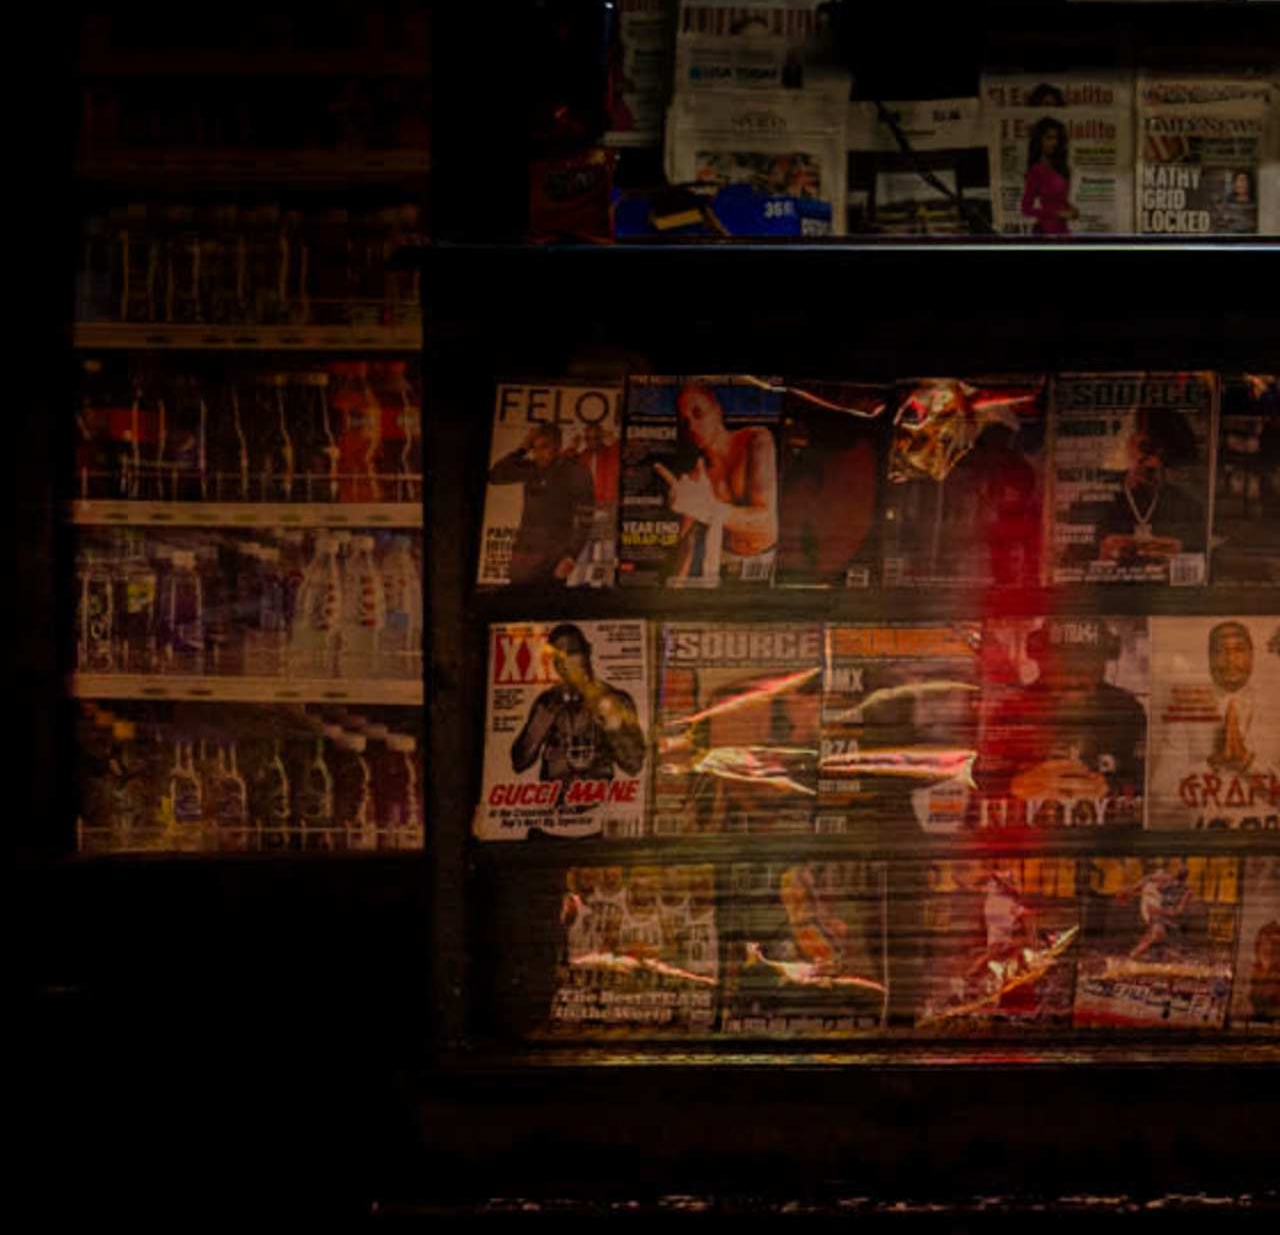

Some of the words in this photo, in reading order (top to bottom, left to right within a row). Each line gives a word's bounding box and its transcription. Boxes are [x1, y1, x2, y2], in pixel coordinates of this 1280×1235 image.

[1142, 166, 1200, 189] KATHY
[1143, 190, 1186, 209] GRID
[1142, 210, 1210, 233] LOCKED
[500, 387, 622, 427] FELO
[622, 520, 653, 534] YEAR
[677, 629, 820, 659] SOURCE
[489, 783, 557, 806] GUCCI
[565, 780, 640, 805] MANE
